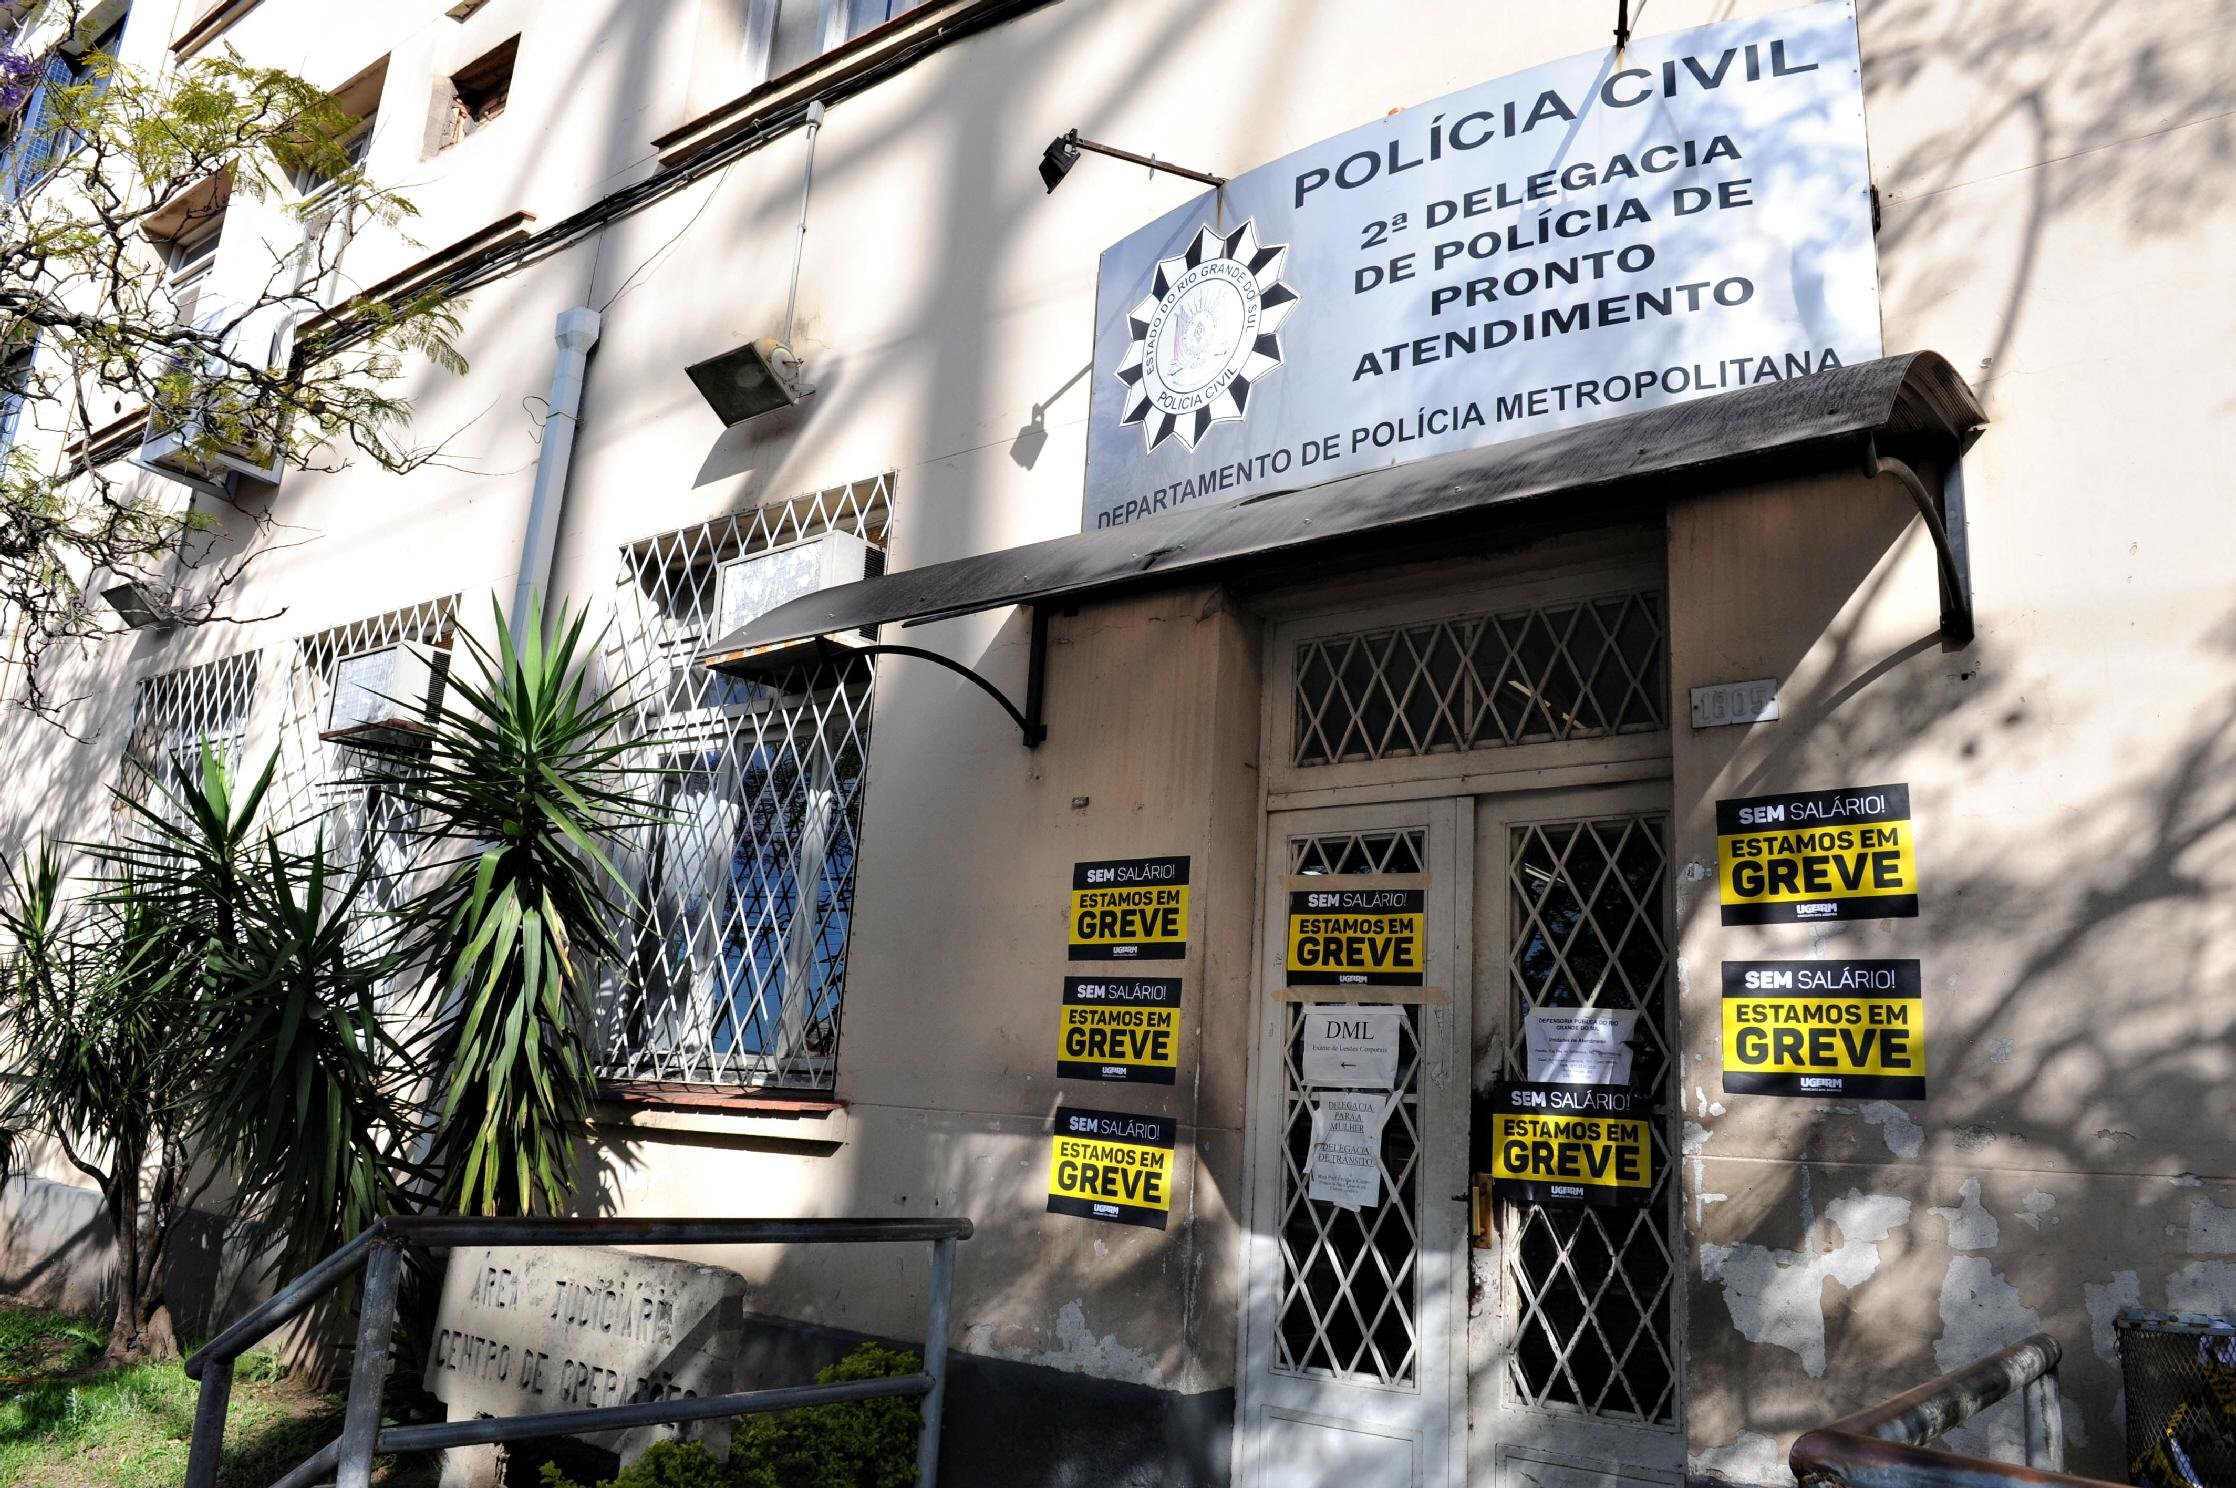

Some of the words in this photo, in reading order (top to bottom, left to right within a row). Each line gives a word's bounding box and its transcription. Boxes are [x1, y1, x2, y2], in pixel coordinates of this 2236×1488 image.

[1295, 89, 1577, 210] POLÍCIA
[1599, 39, 1818, 108] CIVIL
[1361, 211, 1408, 251] 2ª
[1425, 134, 1742, 229] DELEGACIA
[1354, 252, 1416, 294] DE
[1434, 197, 1651, 271] POLÍCIA
[1673, 178, 1753, 216] DE
[1177, 272, 1197, 293] RIO
[1201, 264, 1246, 283] GRANDE
[1431, 243, 1655, 316] PRONTO
[1243, 280, 1256, 300] DO
[1160, 293, 1175, 314] DO
[1247, 304, 1256, 329] SUL
[1352, 276, 1755, 382] ATENDIMENTO
[1146, 318, 1162, 375] ESTADO
[1157, 390, 1203, 410] POLÍCIA
[1205, 366, 1238, 398] CIVIL
[1098, 448, 1292, 529] DEPARTAMENTO
[1301, 433, 1341, 467] DE
[1351, 401, 1486, 454] POLÍCIA
[1495, 346, 1843, 422] METROPOLITANA
[1739, 804, 1784, 824] SEM
[1790, 794, 1886, 821] SALÁRIO!
[1731, 832, 1854, 858] ESTAMOS
[1860, 828, 1898, 848] EM
[1087, 868, 1114, 883] SEM
[1118, 864, 1175, 881] SALÁRIO!
[1732, 850, 1902, 898] GREVE
[1080, 891, 1153, 908] ESTAMOS
[1156, 890, 1180, 905] EM
[1308, 894, 1340, 908] SEM
[1343, 892, 1407, 908] SALÁRIO!
[1078, 908, 1180, 939] GREVE
[1300, 918, 1384, 934] ESTAMOS
[1388, 918, 1414, 934] EM
[1297, 936, 1414, 967] GREVE
[1745, 970, 1792, 989] SEM
[1798, 967, 1896, 989] SALÁRIO!
[1078, 984, 1106, 998] SEM
[1108, 983, 1166, 1000] SALÁRIO!
[1069, 1010, 1144, 1026] ESTAMOS
[1146, 1012, 1171, 1028] EM
[1736, 1004, 1862, 1024] ESTAMOS
[1868, 1004, 1908, 1024] EM
[1325, 1020, 1374, 1040] DML
[1066, 1026, 1170, 1060] GREVE
[1736, 1026, 1911, 1068] GREVE
[1328, 1102, 1374, 1112] DELEGACIA
[1512, 1090, 1546, 1107] SEM
[1550, 1090, 1630, 1111] SALÁRIO!
[1070, 1116, 1098, 1132] SEM
[1101, 1120, 1160, 1140] SALÁRIO!
[1330, 1122, 1364, 1133] MULHER
[1504, 1119, 1601, 1141] ESTAMOS
[1607, 1124, 1638, 1142] EM
[1060, 1142, 1136, 1165] ESTAMOS
[1140, 1152, 1164, 1169] EM
[1318, 1154, 1332, 1163] DE
[1322, 1143, 1369, 1155] DELEGACIA
[1504, 1140, 1640, 1181] GREVE
[1058, 1160, 1162, 1204] GREVE
[437, 1328, 510, 1382] CENTRO
[521, 1349, 548, 1395] DE
